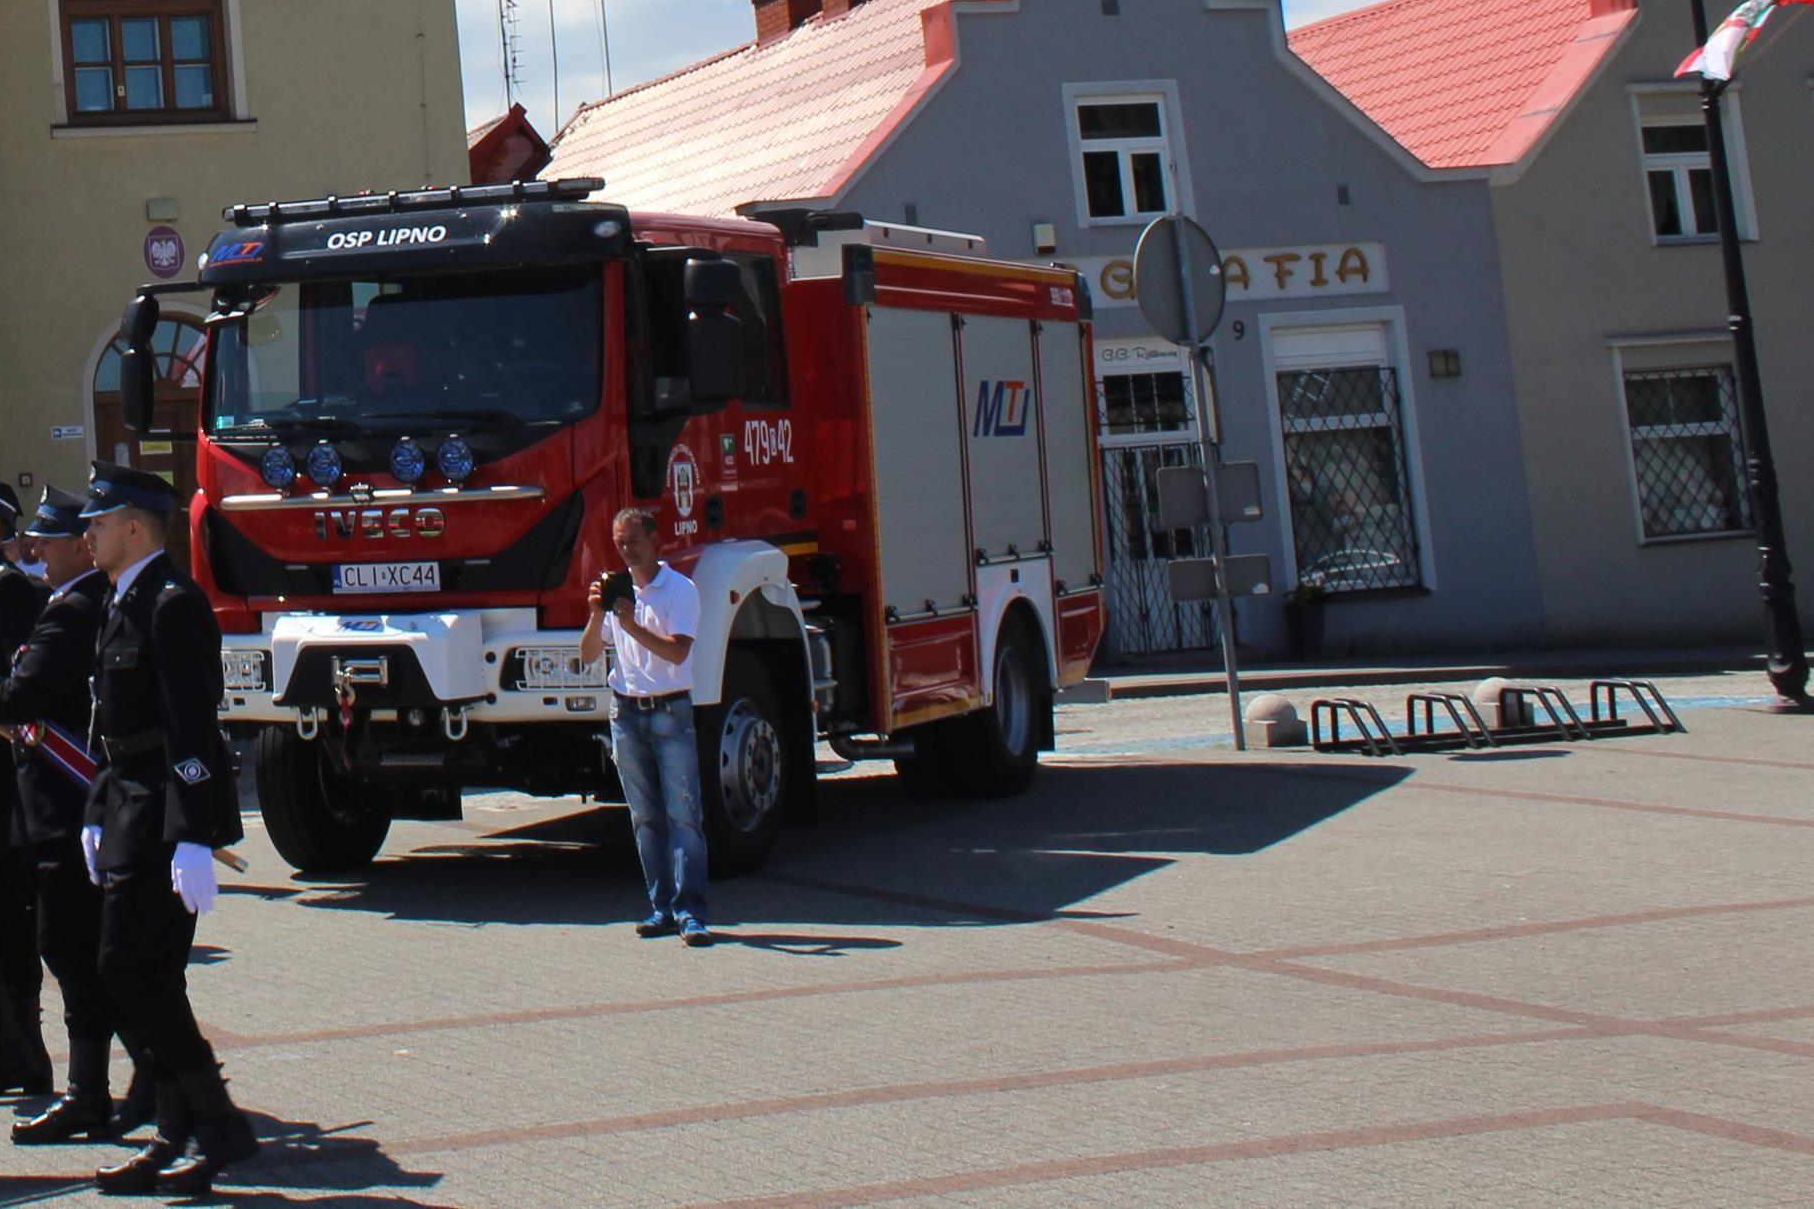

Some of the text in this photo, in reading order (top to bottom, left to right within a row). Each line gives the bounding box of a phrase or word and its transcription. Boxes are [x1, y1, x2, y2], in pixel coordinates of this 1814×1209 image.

[327, 226, 446, 250] OSP LIPNO
[1101, 247, 1370, 300] GAFIA
[1232, 320, 1245, 341] 9
[314, 507, 445, 539] IVECO
[674, 519, 698, 536] LIPNO
